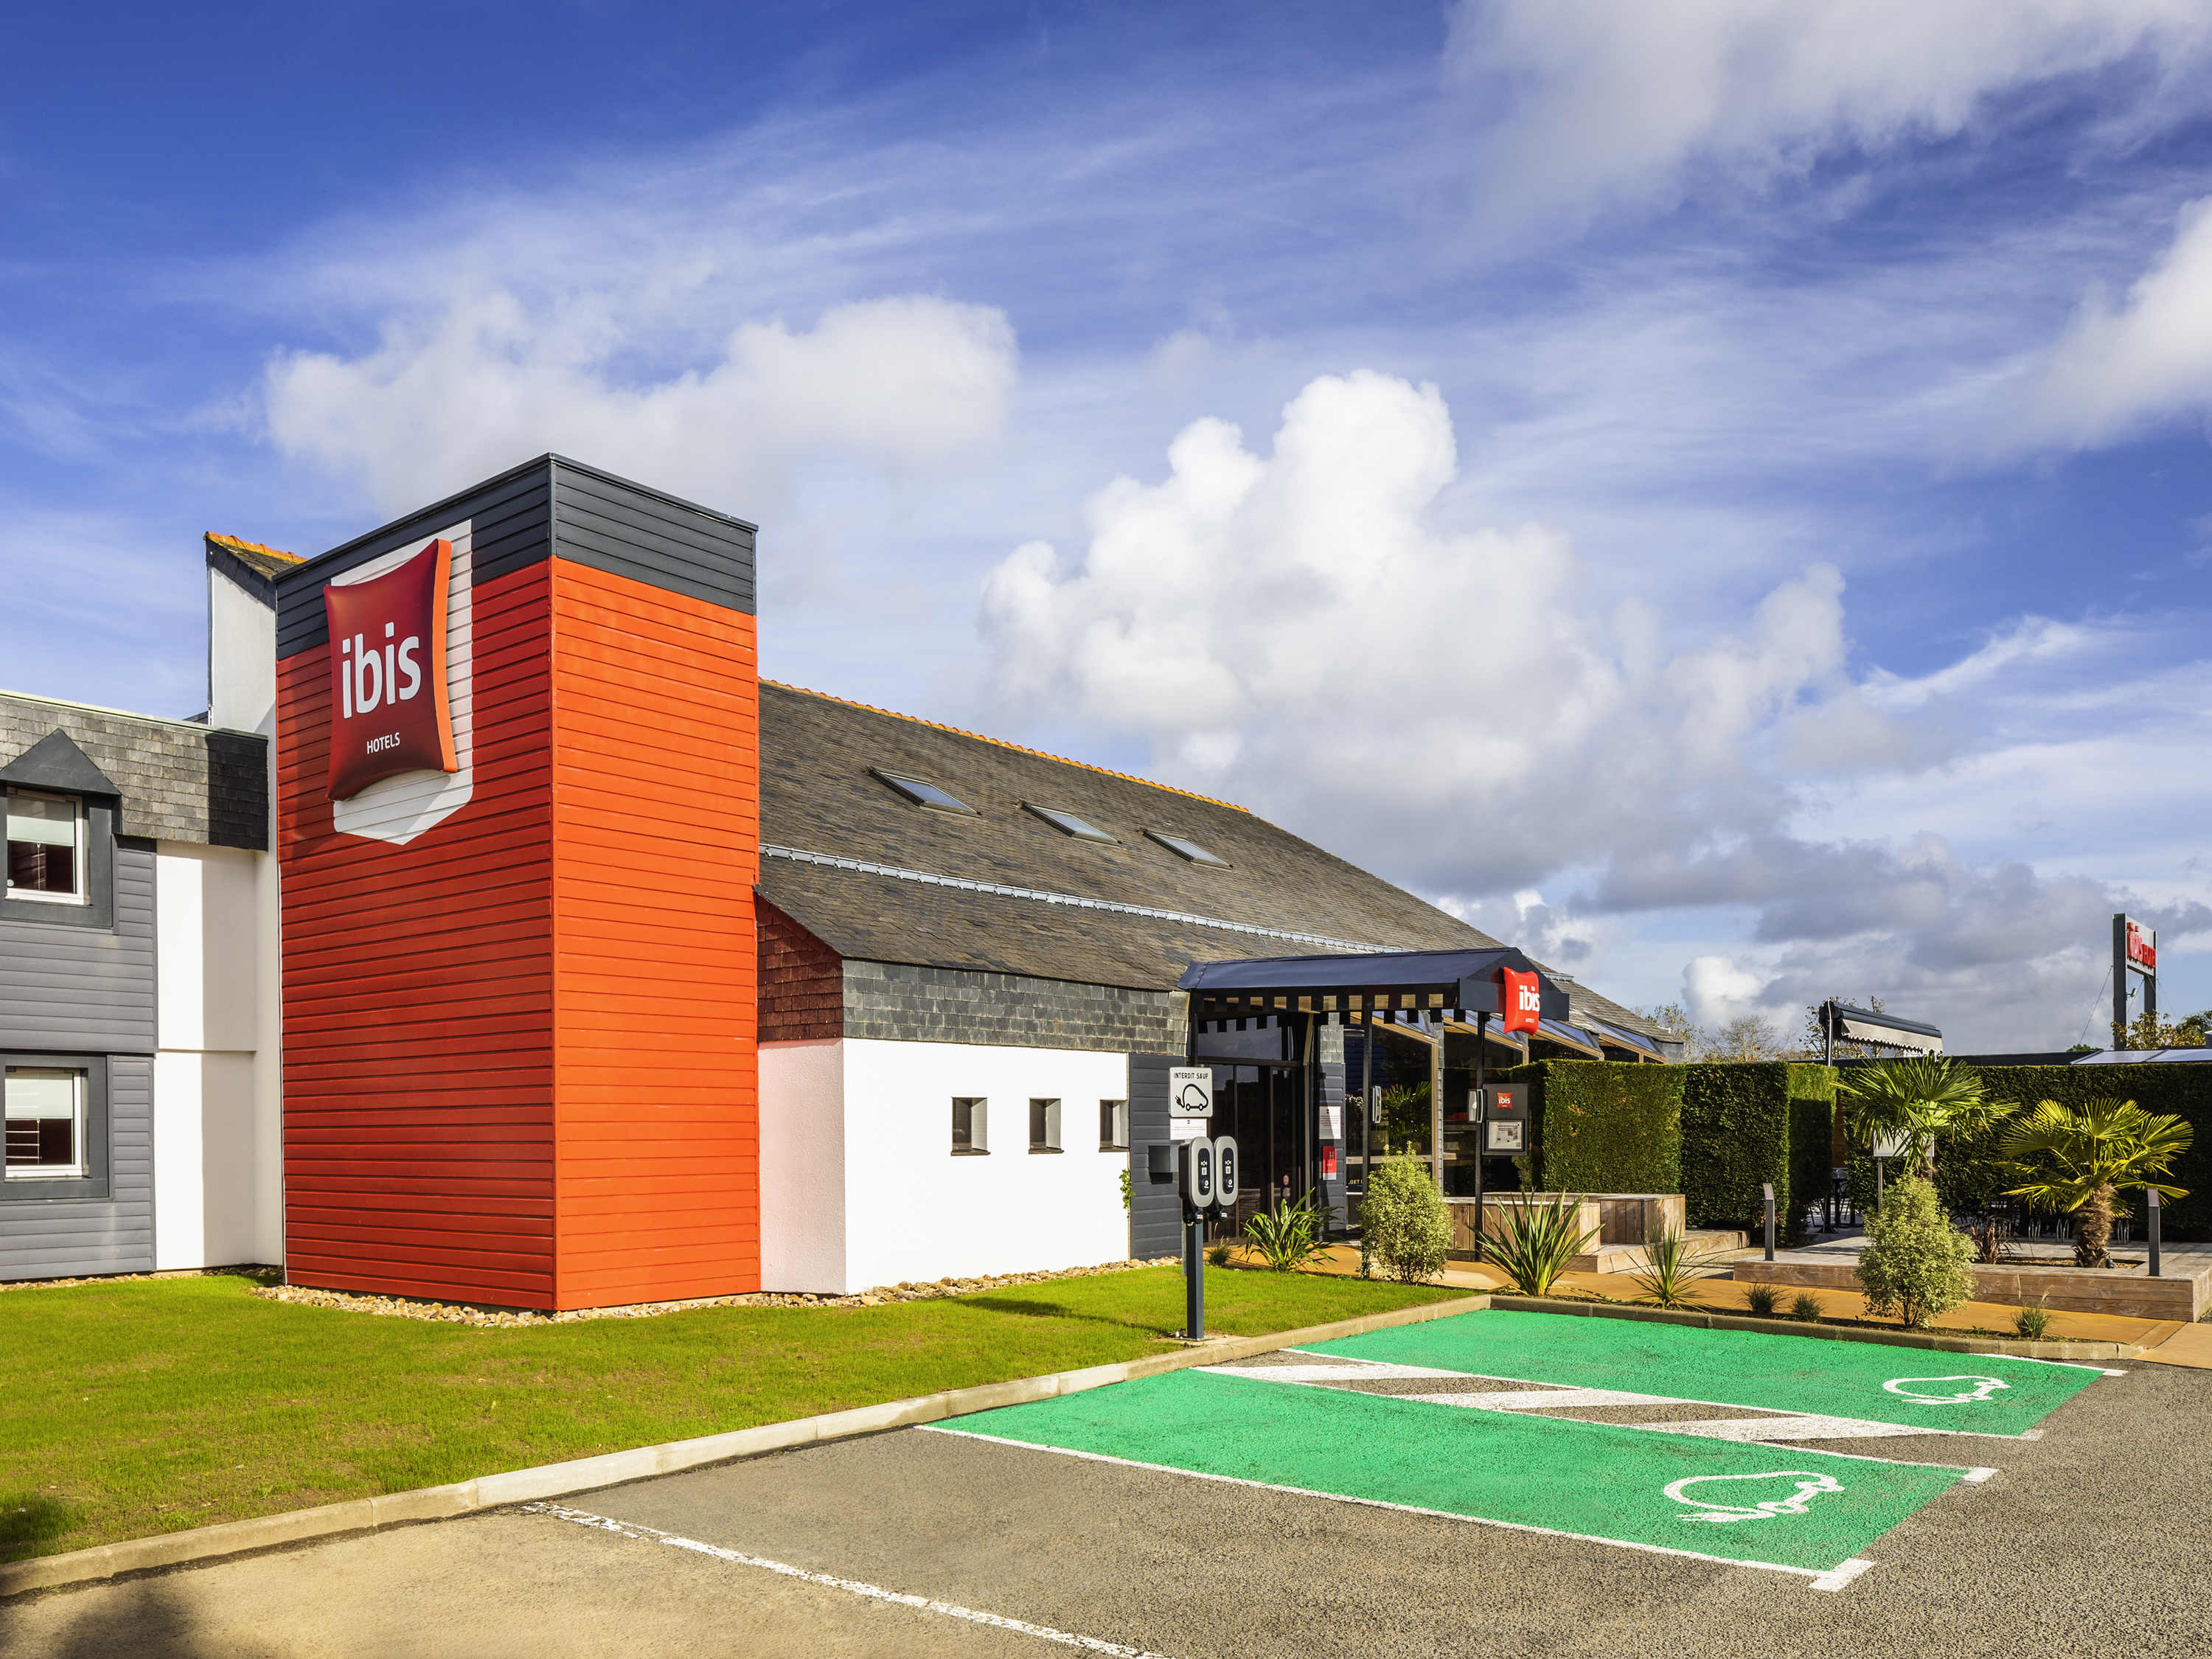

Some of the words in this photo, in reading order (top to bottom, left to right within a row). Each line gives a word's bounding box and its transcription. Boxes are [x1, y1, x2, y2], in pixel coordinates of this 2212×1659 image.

[342, 622, 422, 720] ibis
[366, 732, 400, 755] HOTELS
[1519, 984, 1540, 1012] ibis
